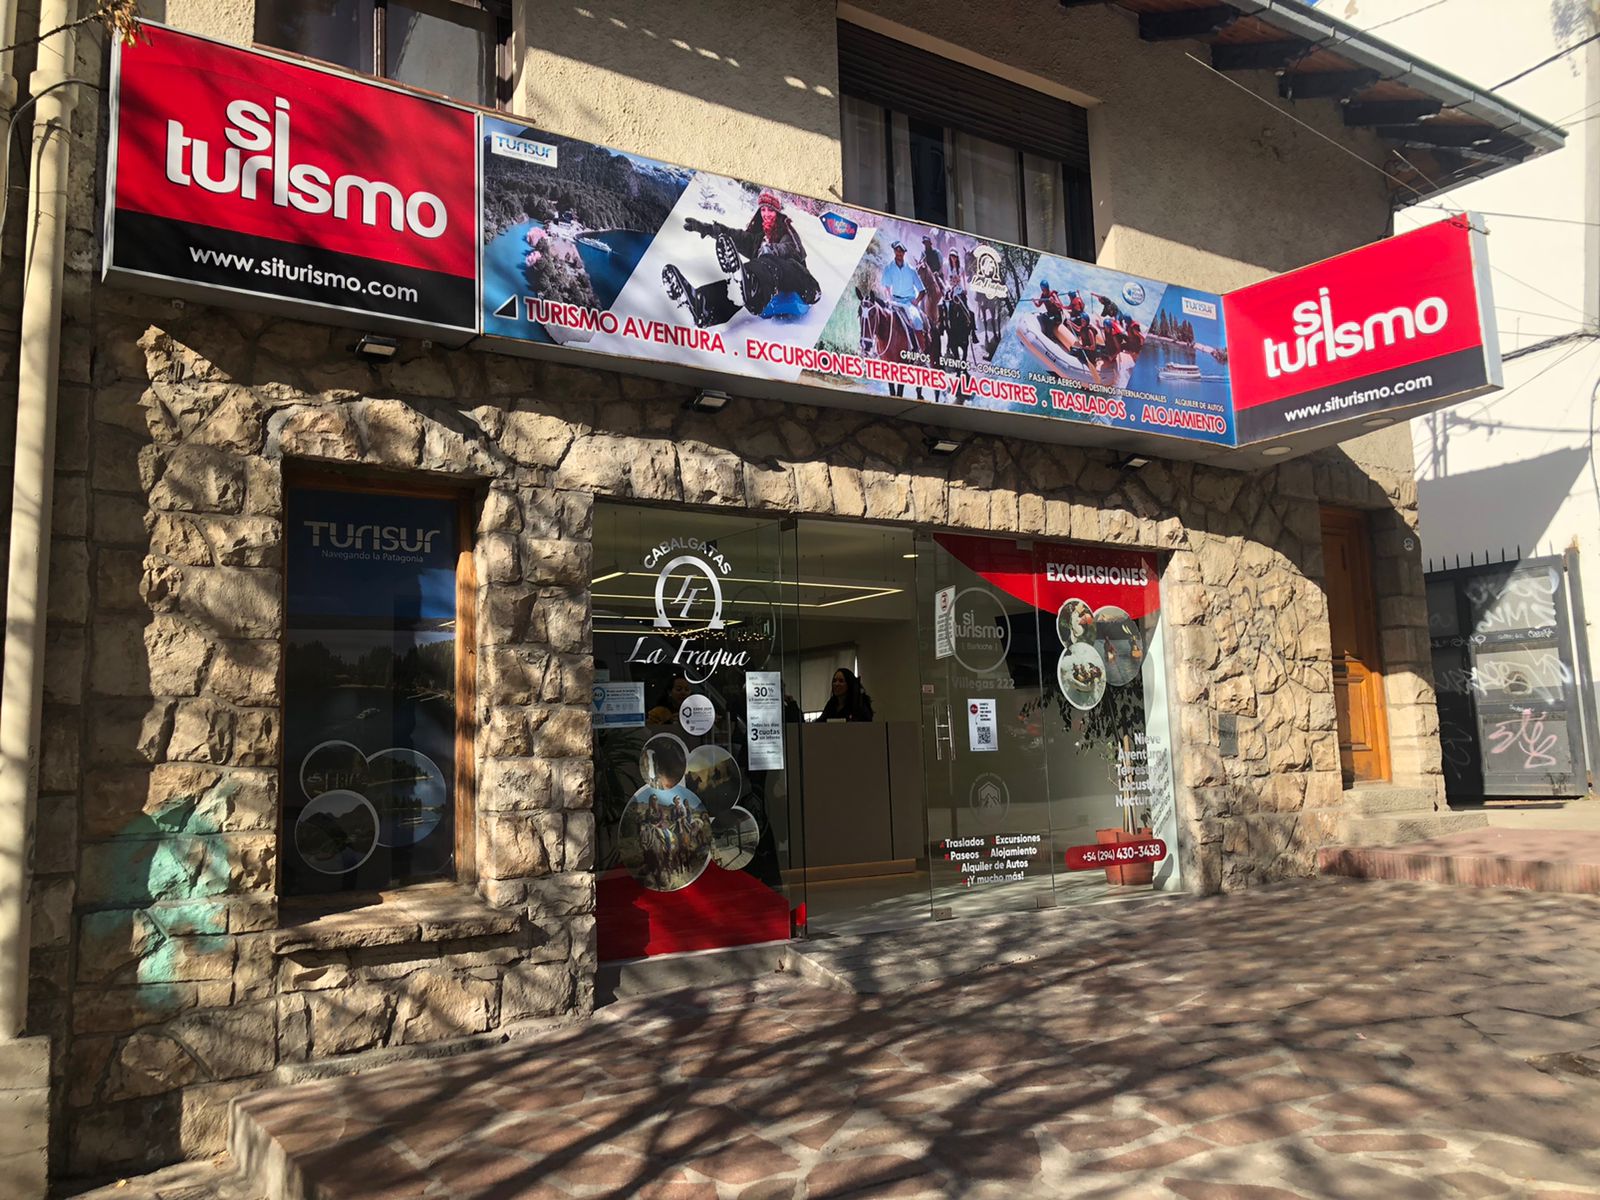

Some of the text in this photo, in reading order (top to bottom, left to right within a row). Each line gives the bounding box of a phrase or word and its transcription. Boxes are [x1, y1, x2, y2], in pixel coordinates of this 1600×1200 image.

[166, 118, 448, 239] turismo
[188, 245, 419, 303] www.siturismo.com
[1264, 297, 1449, 378] turismo
[525, 298, 618, 332] TURISMO
[623, 317, 726, 354] AVENTURA
[747, 340, 862, 377] EXCURSIONES
[865, 361, 946, 391] TERRESTRES
[962, 375, 1037, 405] LACUSTRES
[1051, 390, 1126, 419] TRASLADOS
[1142, 406, 1226, 433] ALOJAMIENTO
[899, 350, 931, 363] GRUPOS
[939, 356, 970, 370] EVENTOS
[977, 364, 1021, 379] CONGRESOS
[1028, 373, 1056, 385] PASAJES
[1057, 378, 1082, 389] AEREOS
[1089, 383, 1116, 395] DESTINOS
[1117, 388, 1167, 403] INTERNACIONALES
[1175, 397, 1199, 408] ALQUILER
[1207, 403, 1224, 413] AUTOS
[1284, 374, 1433, 422] www.siturismo.com
[321, 549, 424, 564] Navegando la Patagonia
[643, 537, 732, 575] CABALGATAS
[1046, 562, 1149, 587] EXCURSIONES
[624, 636, 751, 684] La Fragua
[952, 676, 1015, 692] Villegas 222
[751, 728, 758, 741] 3
[1134, 732, 1161, 745] Nieve
[945, 837, 985, 849] Traslados
[995, 833, 1041, 845] Excursiones
[950, 850, 980, 861] Paseos
[990, 846, 1038, 859] Alojamiento
[1082, 844, 1161, 863] +54 (294) 430-3438
[961, 859, 1029, 874] Alquiler de Autos
[977, 873, 1004, 885] mucho
[1004, 871, 1025, 881] más!
